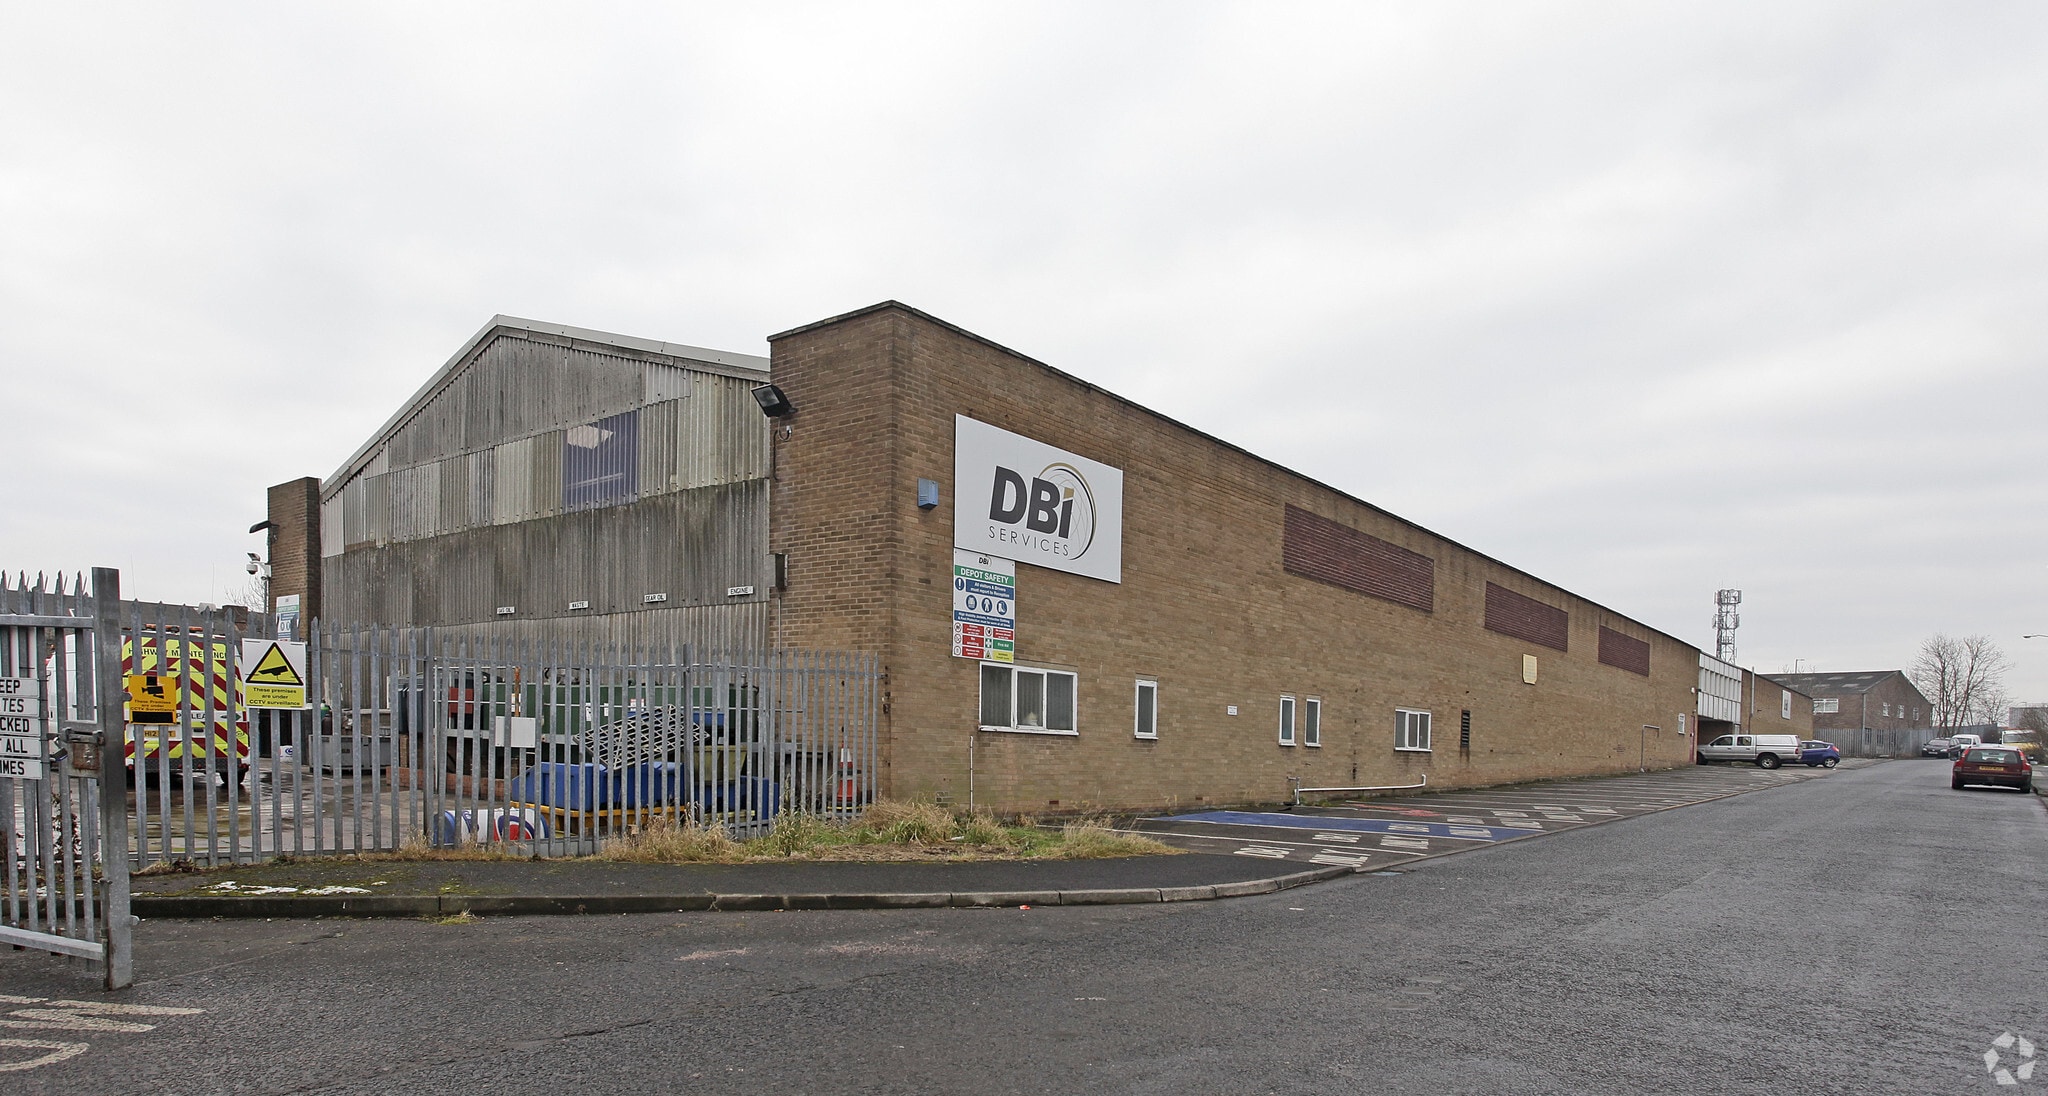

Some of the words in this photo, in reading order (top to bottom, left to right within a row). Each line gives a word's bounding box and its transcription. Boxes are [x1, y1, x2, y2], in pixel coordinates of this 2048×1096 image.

[989, 526, 1069, 556] SERVICES
[960, 568, 984, 579] DEPOT
[984, 572, 1009, 584] SAFETY
[6, 738, 28, 753] ALL
